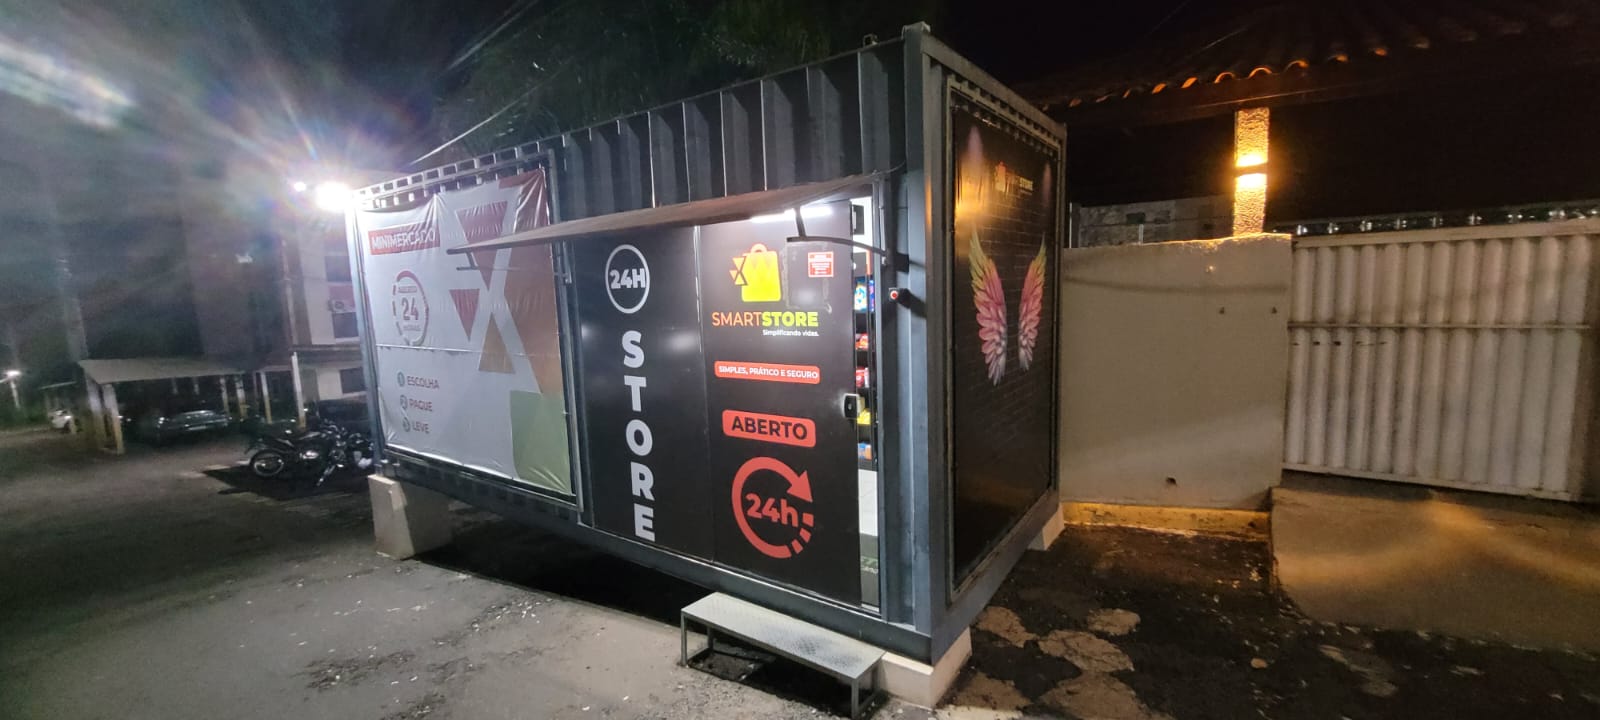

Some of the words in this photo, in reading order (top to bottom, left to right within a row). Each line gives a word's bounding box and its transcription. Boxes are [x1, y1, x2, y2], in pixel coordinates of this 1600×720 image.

[610, 268, 646, 289] 24H
[402, 297, 418, 320] 24
[407, 375, 440, 389] ESCOLHA
[718, 365, 748, 375] SIMPLES,
[749, 367, 779, 376] PRÁTICO
[780, 369, 786, 377] E
[786, 370, 818, 379] SEGURO
[412, 420, 429, 434] LEVE
[621, 330, 655, 542] STORE
[731, 416, 808, 440] ABERTO
[745, 493, 799, 527] 24h
